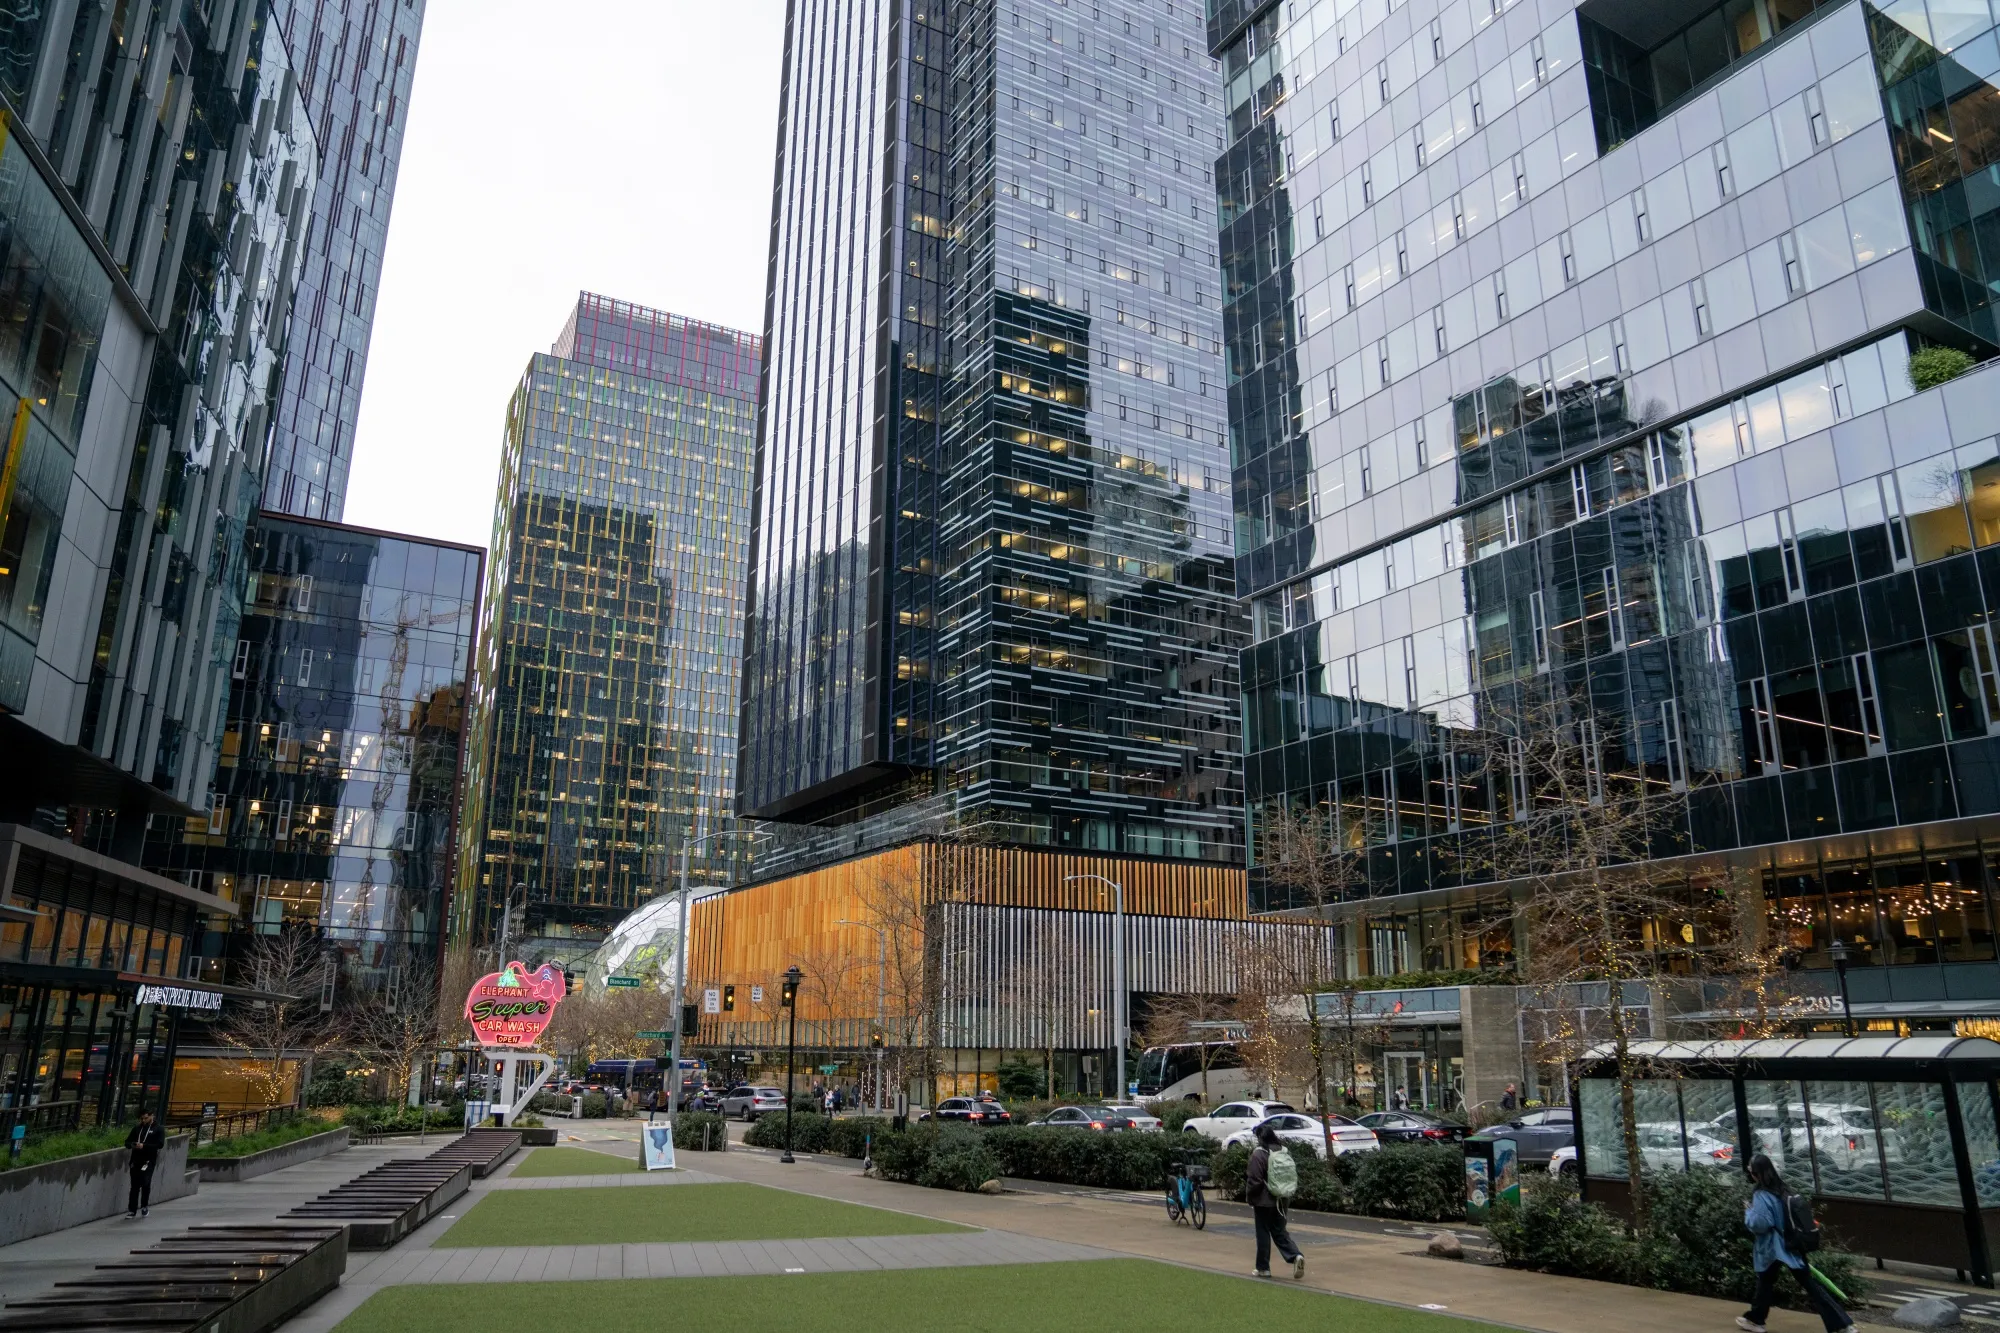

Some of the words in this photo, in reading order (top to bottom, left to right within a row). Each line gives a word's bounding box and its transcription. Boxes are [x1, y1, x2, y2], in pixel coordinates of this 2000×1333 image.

[161, 986, 191, 1006] SUPREME
[190, 990, 223, 1009] DUMPLINGS
[481, 986, 531, 998] ELEPHANT
[472, 999, 550, 1021] Super
[478, 1020, 503, 1032] CAR
[507, 1022, 541, 1033] WASH
